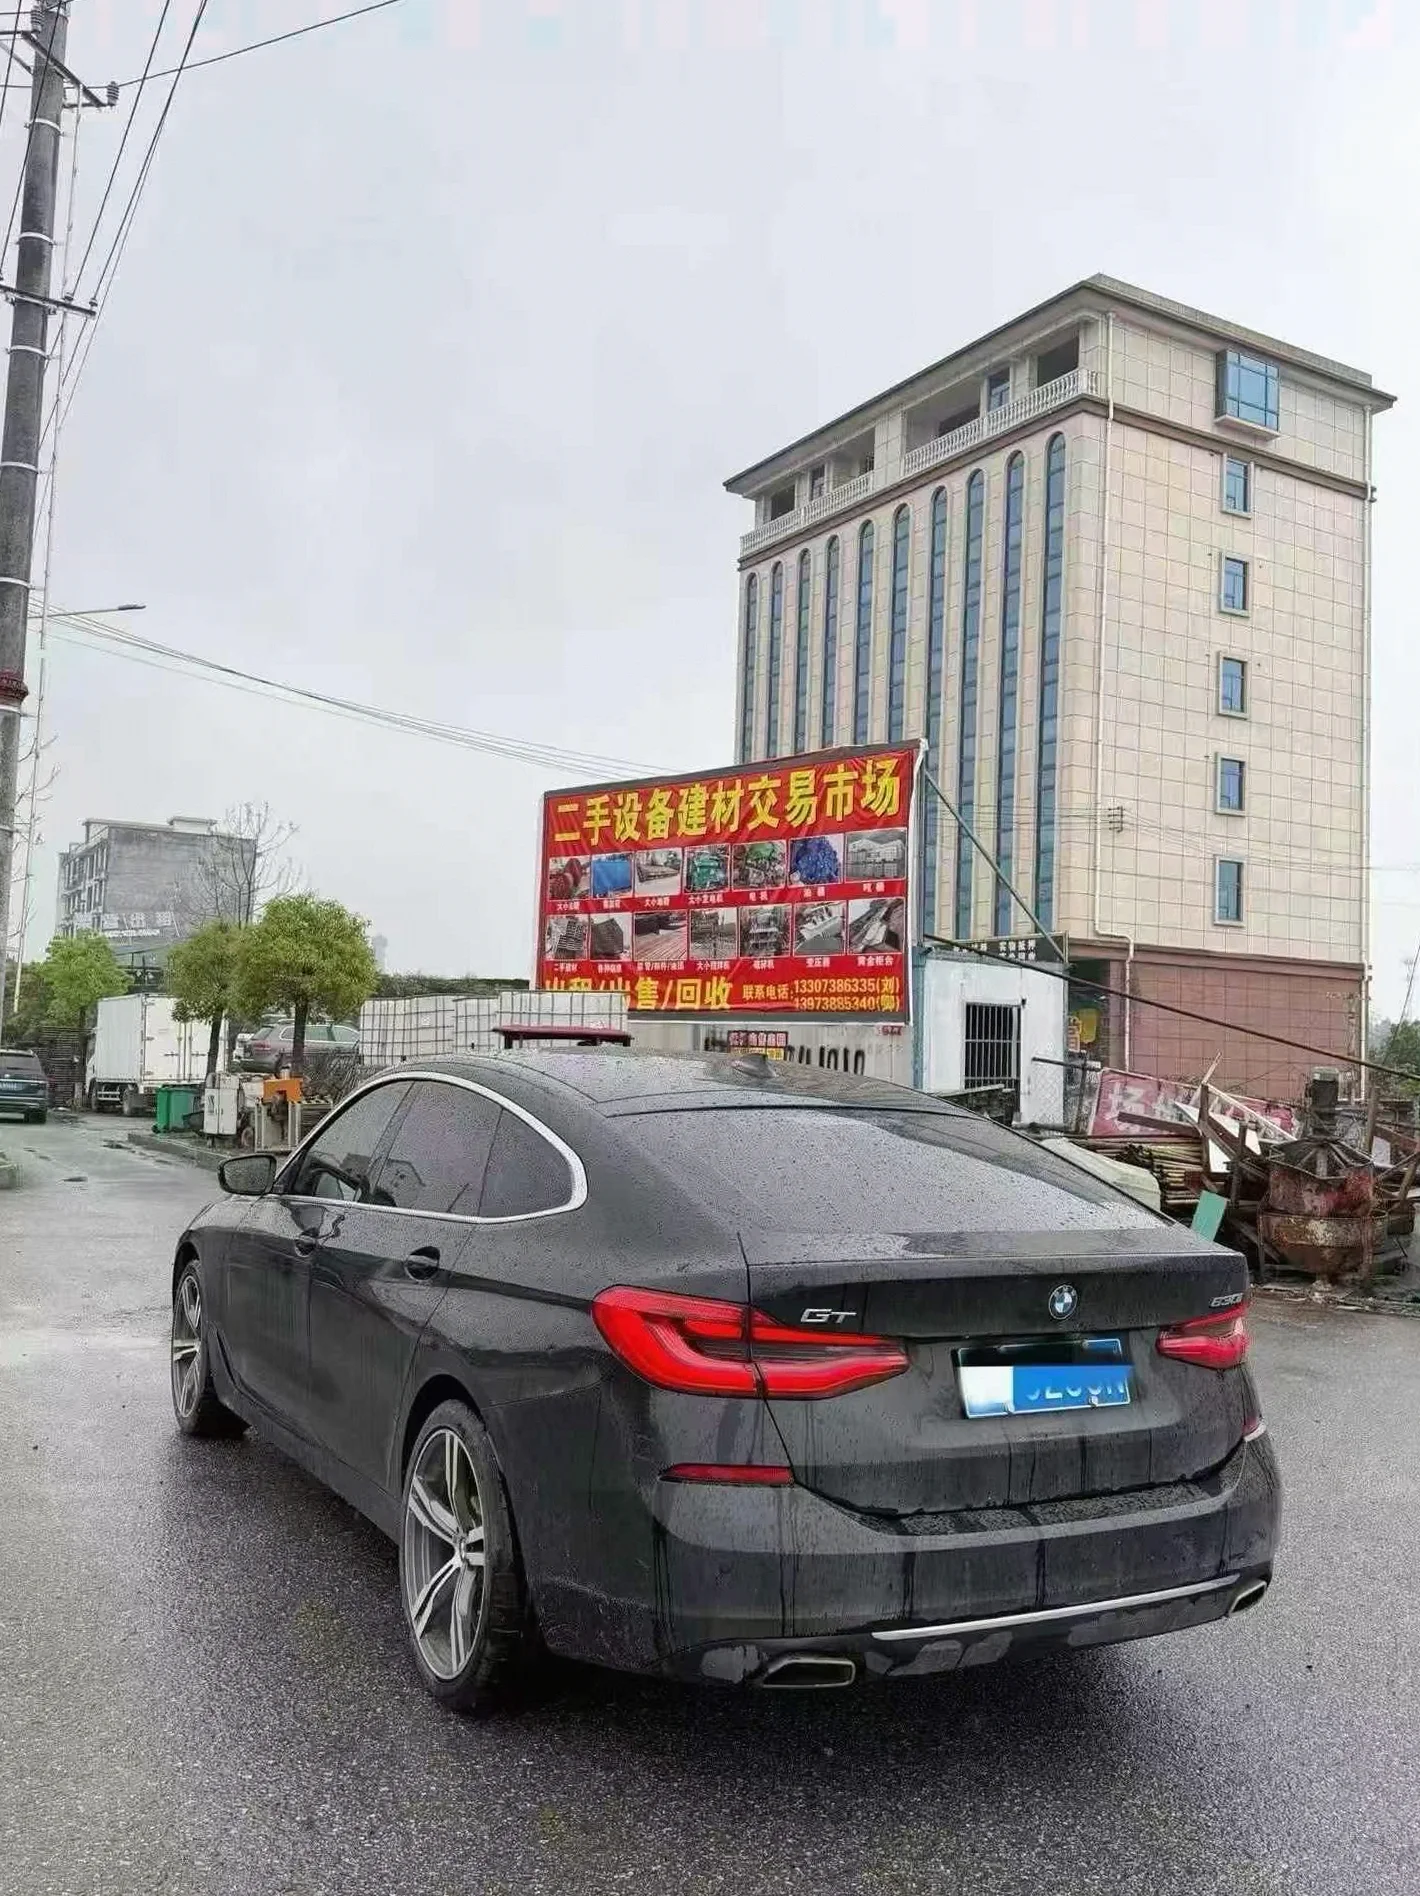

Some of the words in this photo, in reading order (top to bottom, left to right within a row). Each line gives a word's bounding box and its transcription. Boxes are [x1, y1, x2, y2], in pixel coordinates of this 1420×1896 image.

[555, 758, 901, 846] 二手设备建材交易市场
[742, 983, 794, 1001] 联系电话:
[794, 976, 900, 993] 13307386335(刘)
[801, 1307, 857, 1325] GT
